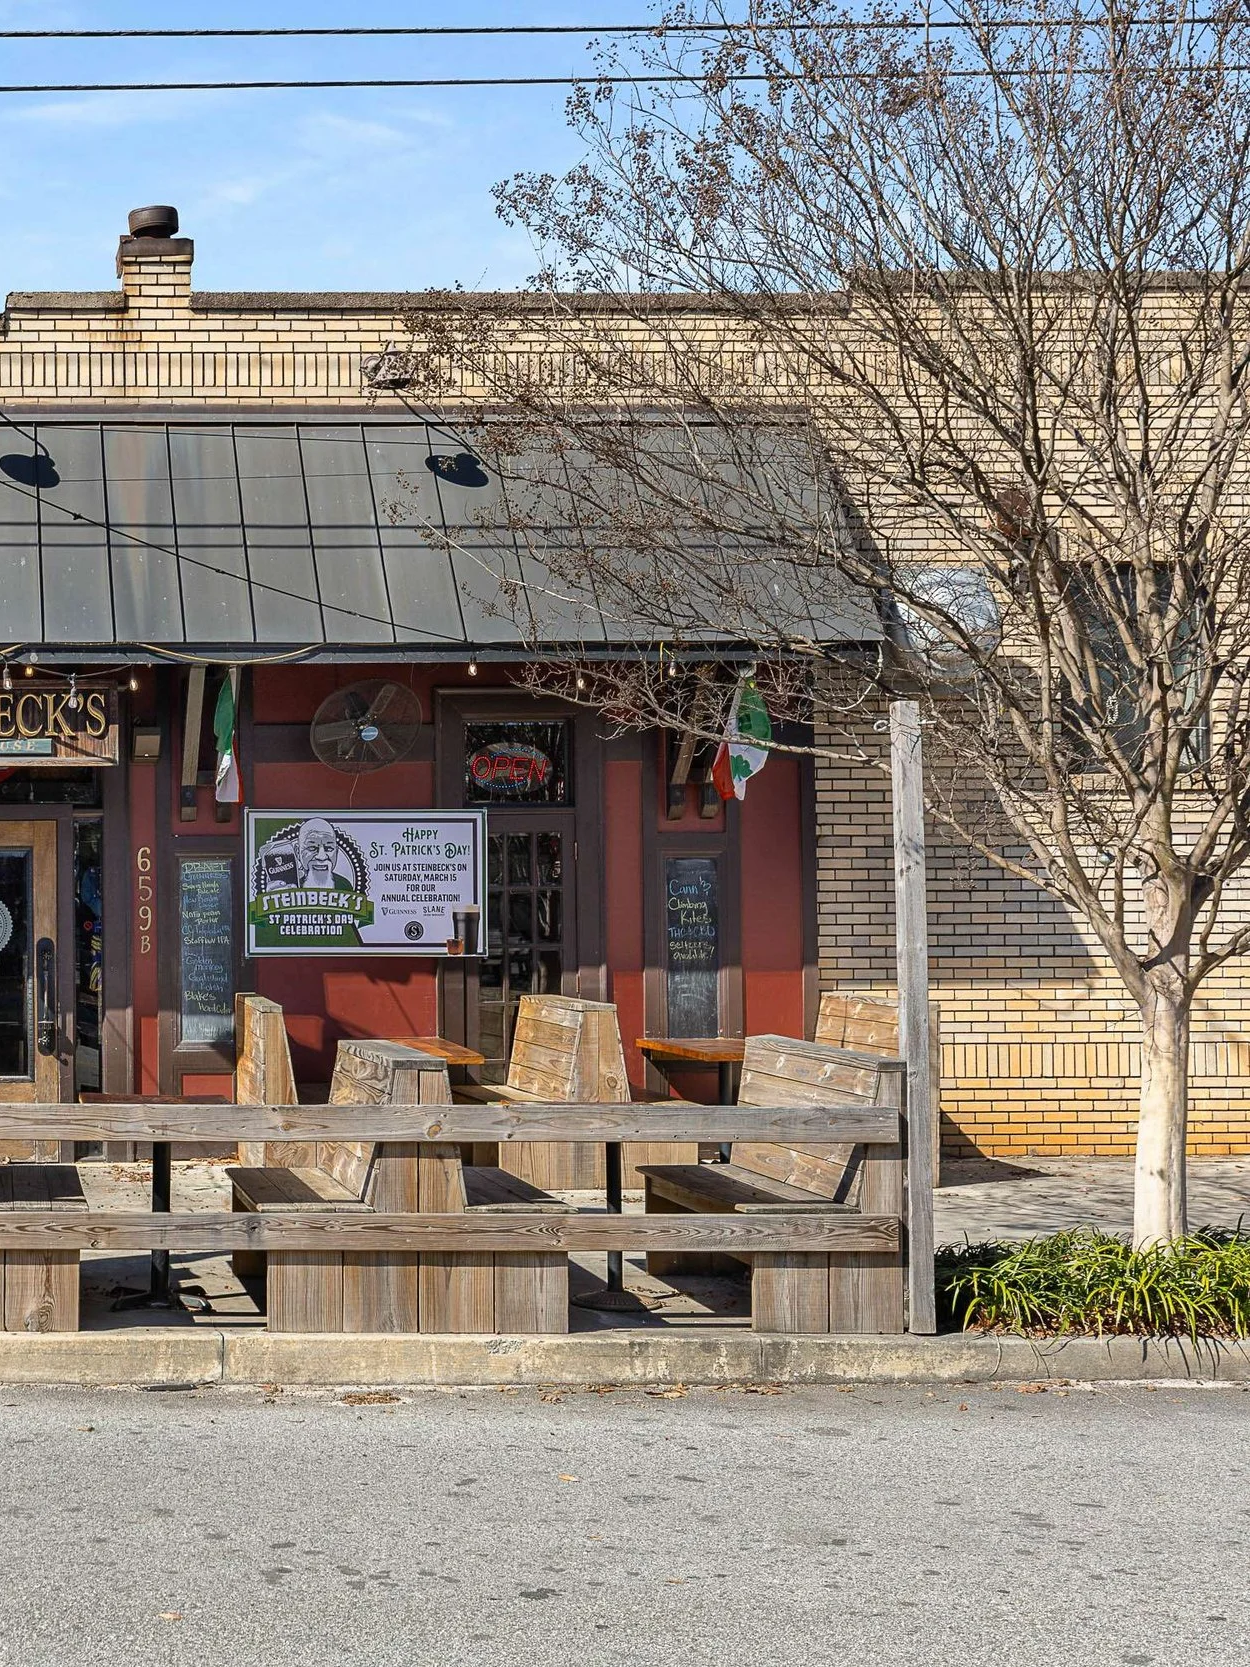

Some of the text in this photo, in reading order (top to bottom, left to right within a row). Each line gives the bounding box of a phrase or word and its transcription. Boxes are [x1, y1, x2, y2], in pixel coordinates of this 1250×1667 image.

[470, 755, 548, 782] OPEN
[268, 862, 294, 875] GUINNESS
[373, 863, 467, 872] JOIN US AT STEINBECK'S ON
[384, 873, 457, 882] SATURDAY, MARCH 15
[406, 884, 436, 892] FOR OUR
[262, 891, 363, 911] STEINBECK'S
[381, 894, 461, 902] ANNUAL CELEBRATION!
[423, 905, 445, 913] SLANE
[668, 896, 708, 915] Climbing
[269, 914, 354, 925] ST PATRICK'S DAY
[279, 925, 343, 935] CELEBRATION
